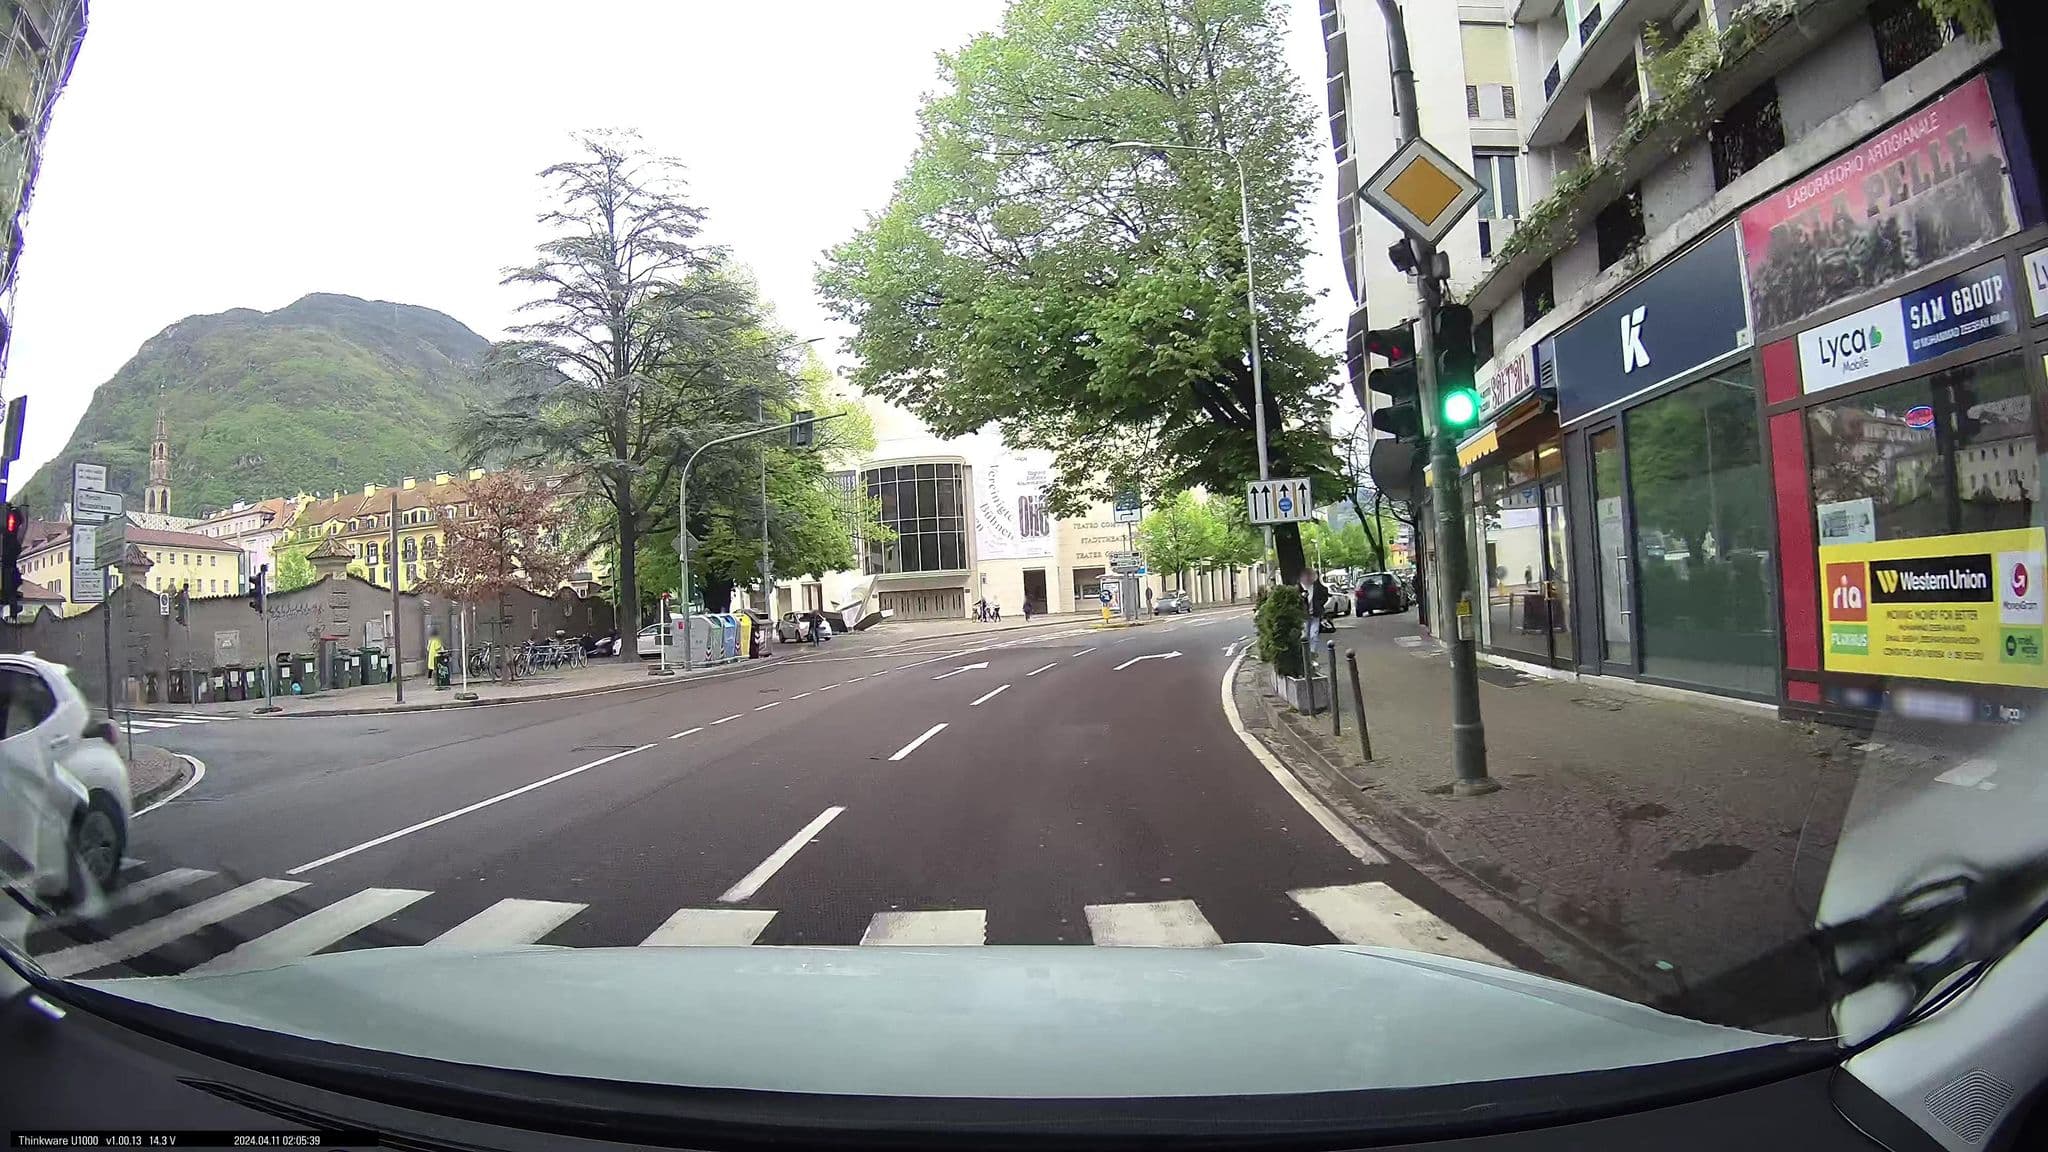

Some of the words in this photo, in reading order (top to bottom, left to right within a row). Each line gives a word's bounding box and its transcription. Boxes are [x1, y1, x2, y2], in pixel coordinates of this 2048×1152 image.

[1786, 156, 1864, 209] LABORATORIO
[1868, 111, 1940, 163] ARTIGIANALE
[1910, 296, 1946, 330] SAM
[1951, 274, 2003, 316] GROUP
[1620, 305, 1651, 374] K
[1819, 327, 1867, 367] Lyca
[1842, 356, 1869, 375] Mobile
[1832, 574, 1863, 609] ria
[1900, 571, 1950, 591] Western
[1950, 568, 1987, 591] Union
